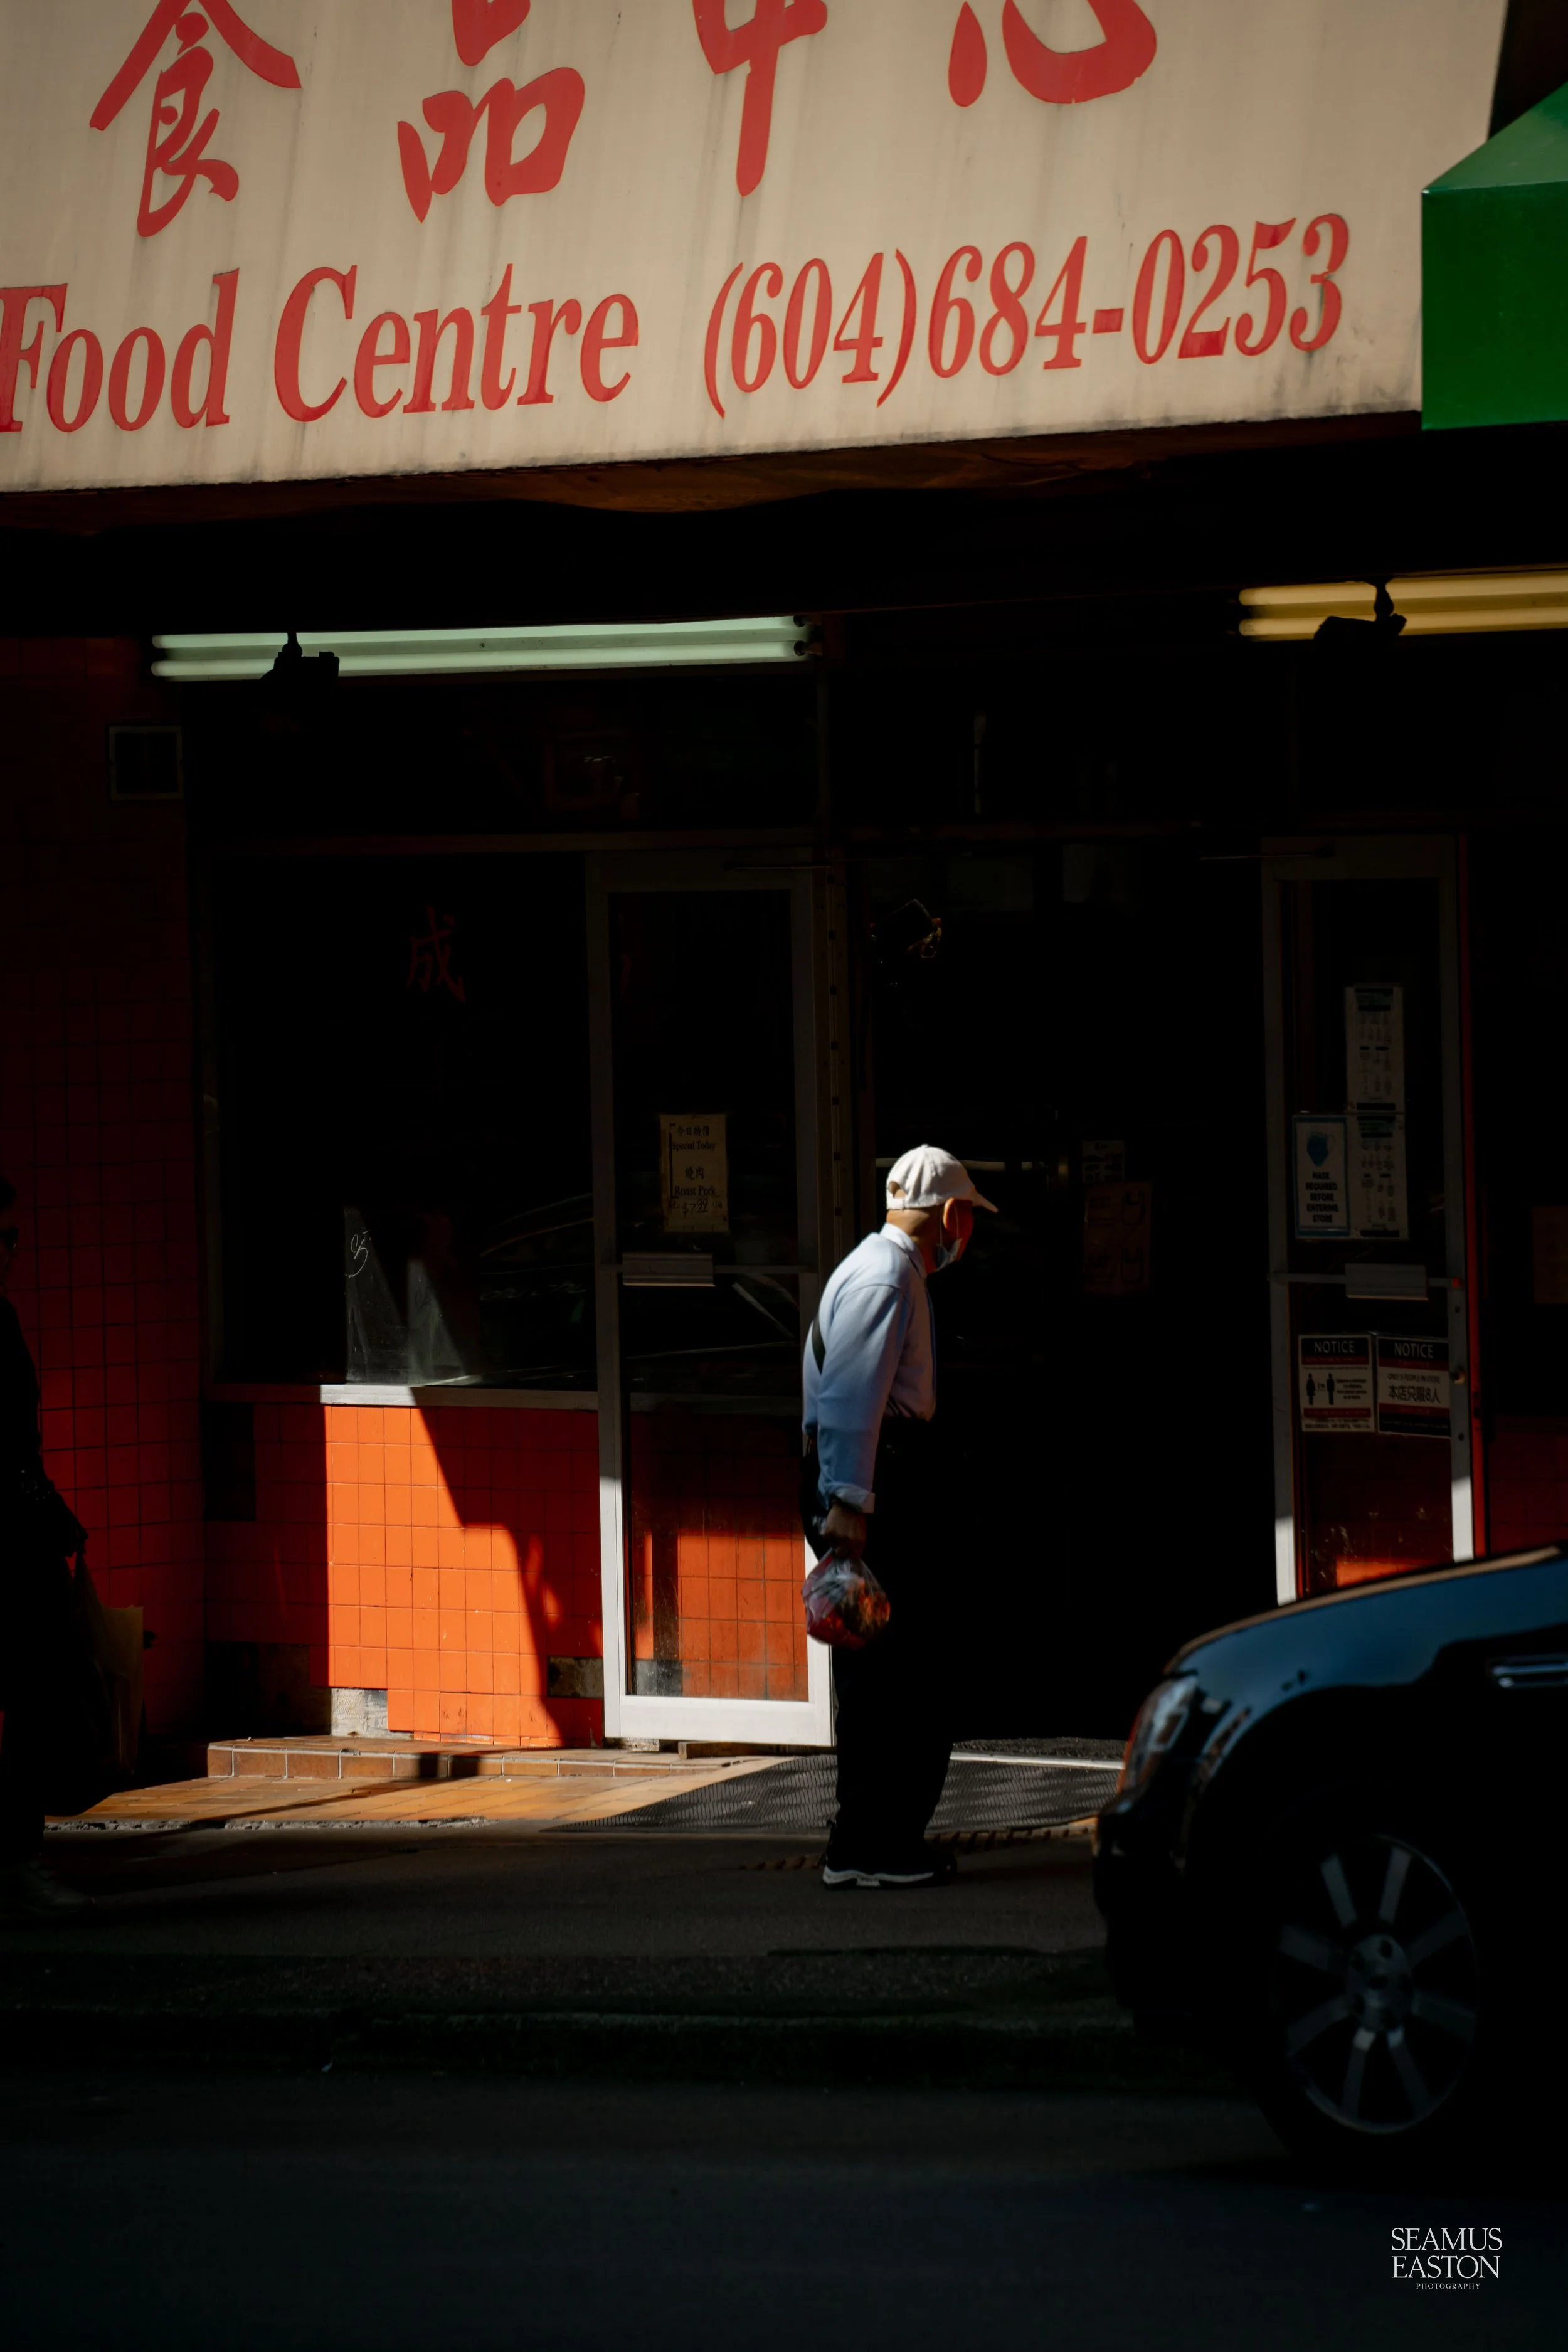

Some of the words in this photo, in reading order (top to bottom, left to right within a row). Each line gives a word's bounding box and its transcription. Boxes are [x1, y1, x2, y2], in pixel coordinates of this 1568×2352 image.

[0, 268, 240, 433] Food
[273, 263, 639, 423] Centre
[704, 213, 1349, 420] (604)684-0253
[405, 903, 467, 1005] 成
[672, 1142, 694, 1152] Special
[696, 1141, 716, 1152] Today
[675, 1186, 696, 1195] Roast
[699, 1185, 716, 1195] Pork
[1306, 1182, 1337, 1190] REQUIRED
[1310, 1193, 1334, 1201] BEFORE
[1306, 1204, 1338, 1212] ENTERING
[1313, 1214, 1333, 1222] STORE
[1314, 1340, 1355, 1353] NOTICE
[1394, 1342, 1434, 1359] NOTICE
